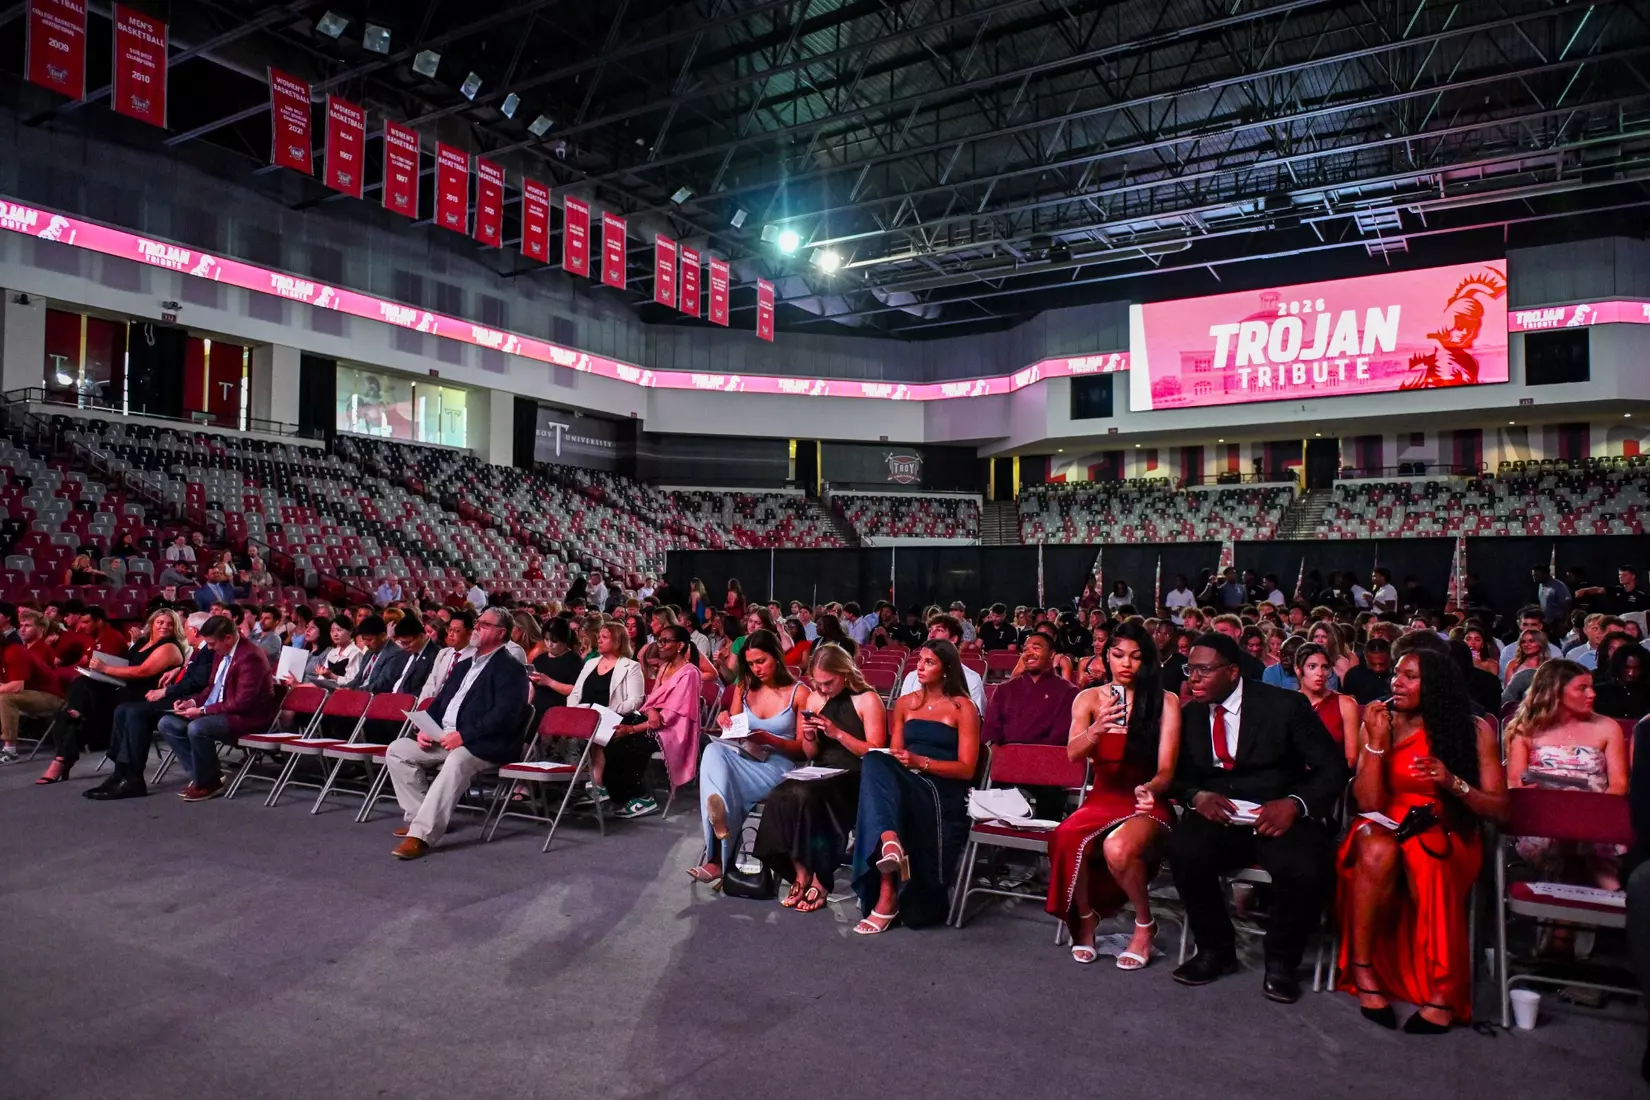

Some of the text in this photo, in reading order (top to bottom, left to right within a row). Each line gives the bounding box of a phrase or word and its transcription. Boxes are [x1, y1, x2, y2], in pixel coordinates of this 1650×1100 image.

[128, 16, 154, 33] MEN'S
[117, 21, 165, 48] BASKETBALL
[48, 37, 69, 53] 2009
[131, 70, 151, 84] 2010
[276, 76, 306, 94] WOMEN'S
[273, 83, 311, 105] BASKETBALL
[329, 109, 365, 131] BASKETBALL
[332, 102, 361, 120] WOMEN'S
[387, 134, 419, 153] BASKETBALL
[390, 127, 415, 144] WOMEN'S
[137, 239, 190, 264] TROJAN
[145, 254, 183, 270] TRIBUTE
[270, 273, 314, 296] TROJAN
[1277, 298, 1325, 316] 2026
[1516, 307, 1565, 325] TROJAN
[1523, 320, 1557, 330] TRIBUTE
[1209, 305, 1401, 369] TROJAN
[1238, 357, 1370, 389] TRIBUTE
[565, 434, 613, 449] UNIVERSITY
[893, 462, 915, 475] TROY
